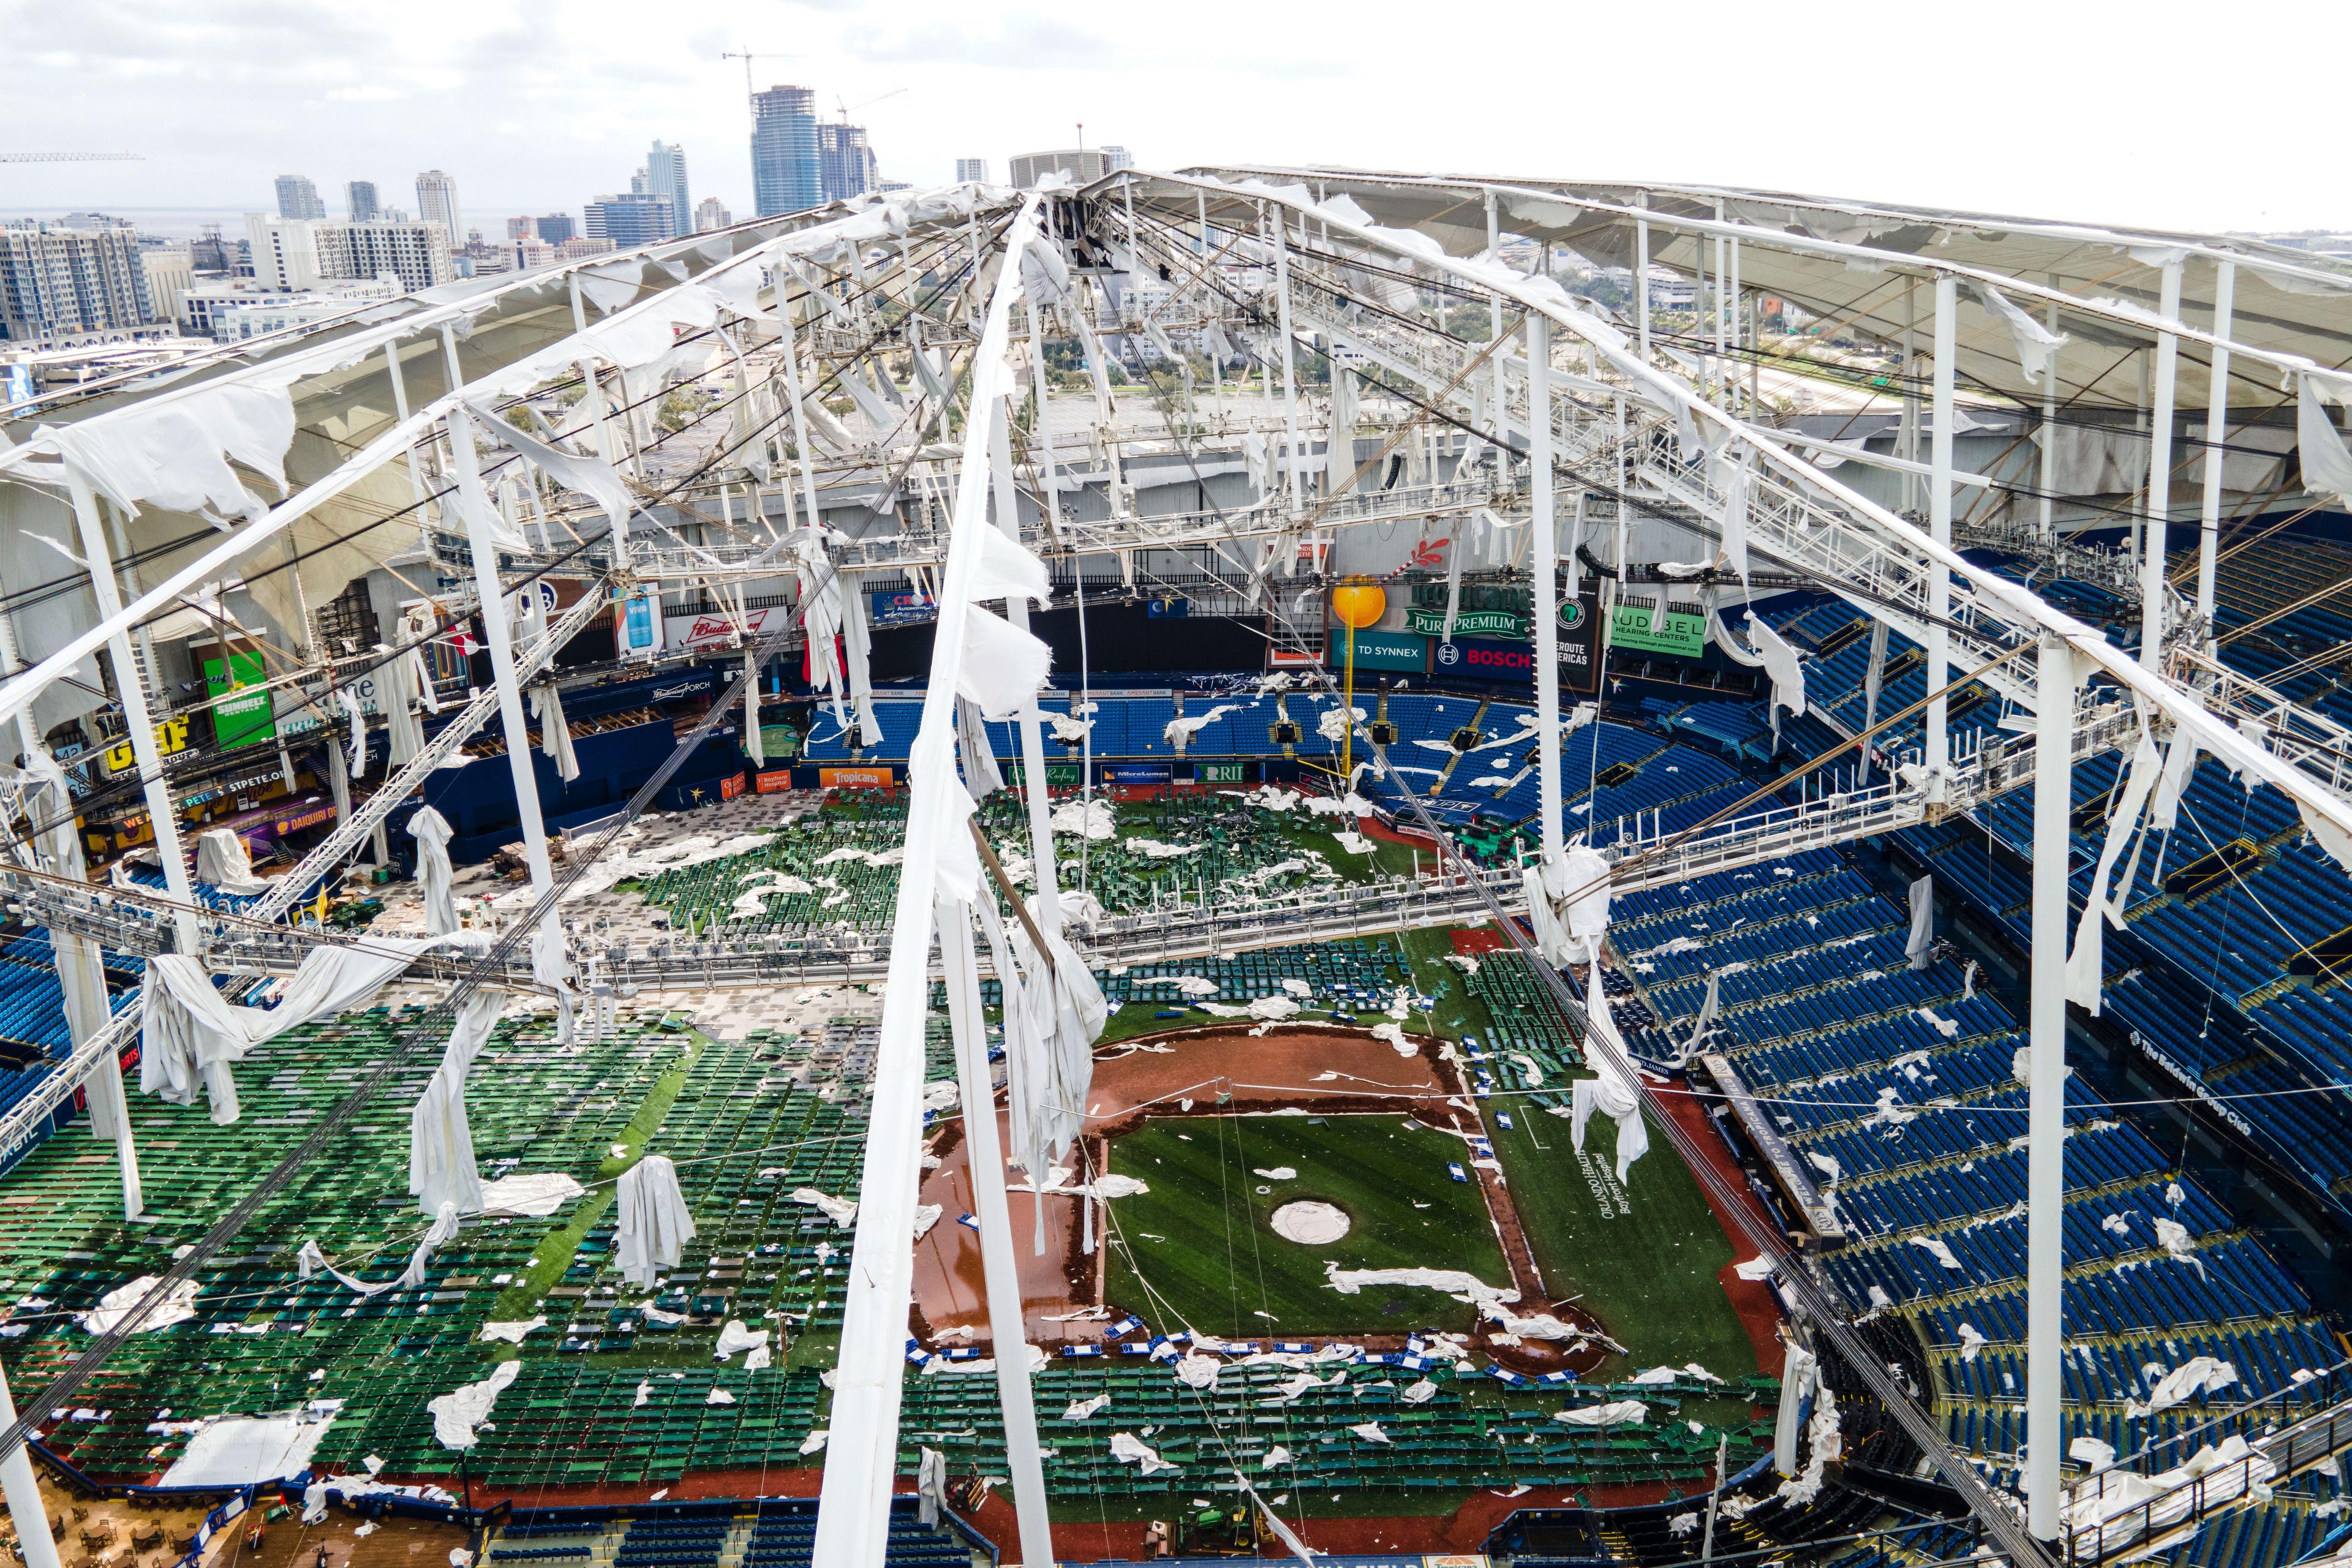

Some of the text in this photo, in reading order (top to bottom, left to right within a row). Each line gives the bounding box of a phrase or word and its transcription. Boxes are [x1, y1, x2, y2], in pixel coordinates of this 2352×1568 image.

[629, 605, 647, 614] VIVA
[1453, 616, 1515, 631] PREMIUM
[1611, 614, 1702, 636] AUDBEL
[1616, 626, 1690, 642] HEARING CENTERS
[1359, 645, 1419, 657] TD SYNNEX
[1556, 641, 1585, 654] EROUTE
[1467, 649, 1531, 669] BOSCH
[1558, 652, 1588, 665] ERICAS
[685, 681, 710, 692] PORCH
[216, 696, 266, 715] SUNBELT
[224, 706, 260, 717] RENTALS
[345, 753, 378, 766] POCH
[764, 774, 788, 783] Bayfront
[833, 772, 879, 785] Tropicana
[1046, 769, 1076, 782] Roofing
[186, 792, 213, 807] PETE
[290, 806, 337, 831] DAIQUIRI DE
[1646, 1063, 1669, 1075] JAMES
[2141, 1039, 2252, 1137] The Baldwin Group Club
[1740, 1101, 1775, 1145] TROPICANA
[1771, 1148, 1785, 1159] TO
[1593, 1153, 1632, 1215] Bayfront Hospital
[1588, 1178, 1615, 1219] ORLANDO
